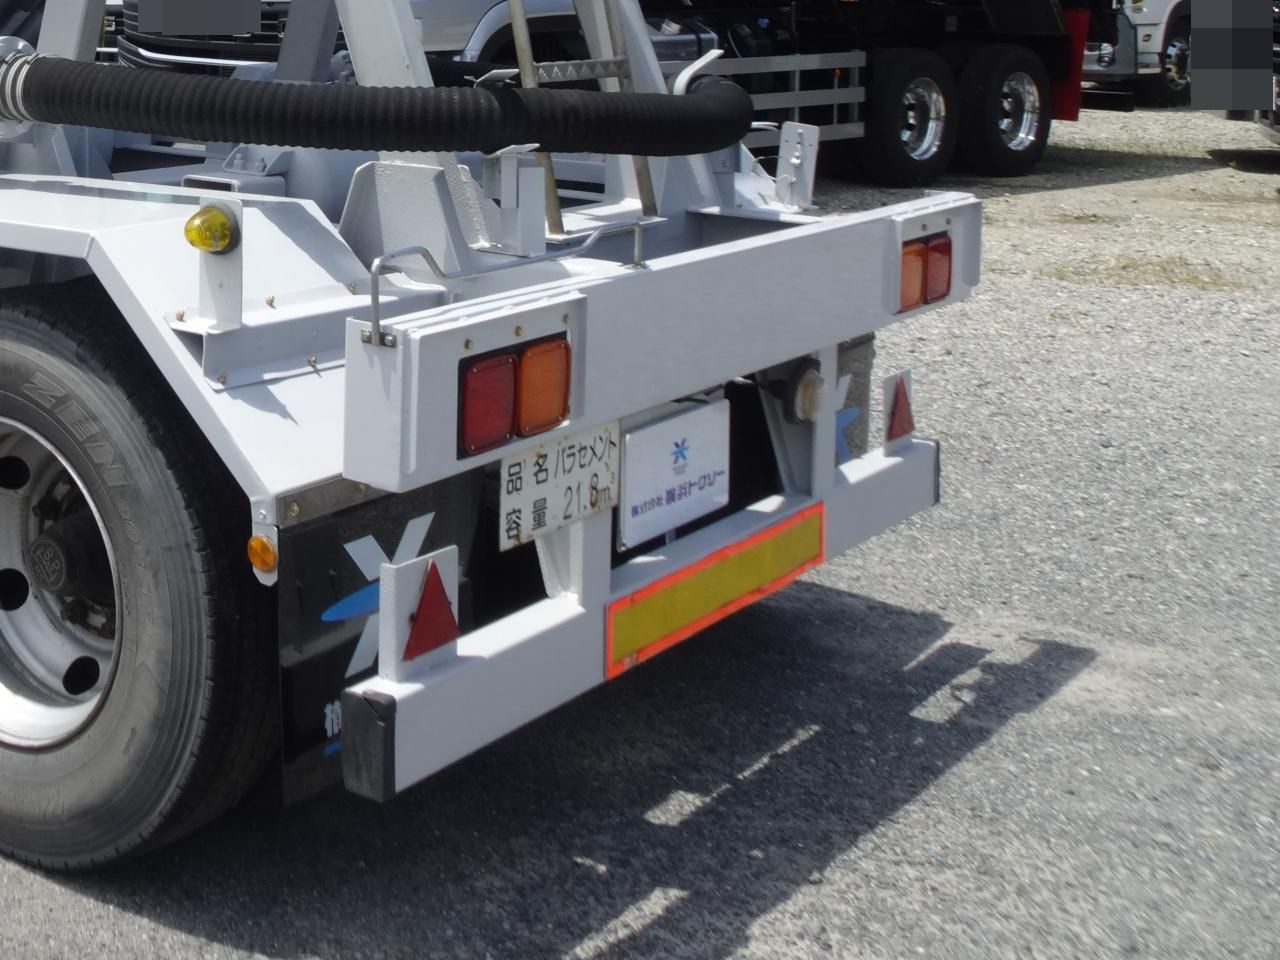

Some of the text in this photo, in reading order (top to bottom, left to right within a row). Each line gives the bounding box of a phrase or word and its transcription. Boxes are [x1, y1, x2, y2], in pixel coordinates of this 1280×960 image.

[21, 371, 132, 487] ZEN
[554, 432, 617, 478] バラセメント
